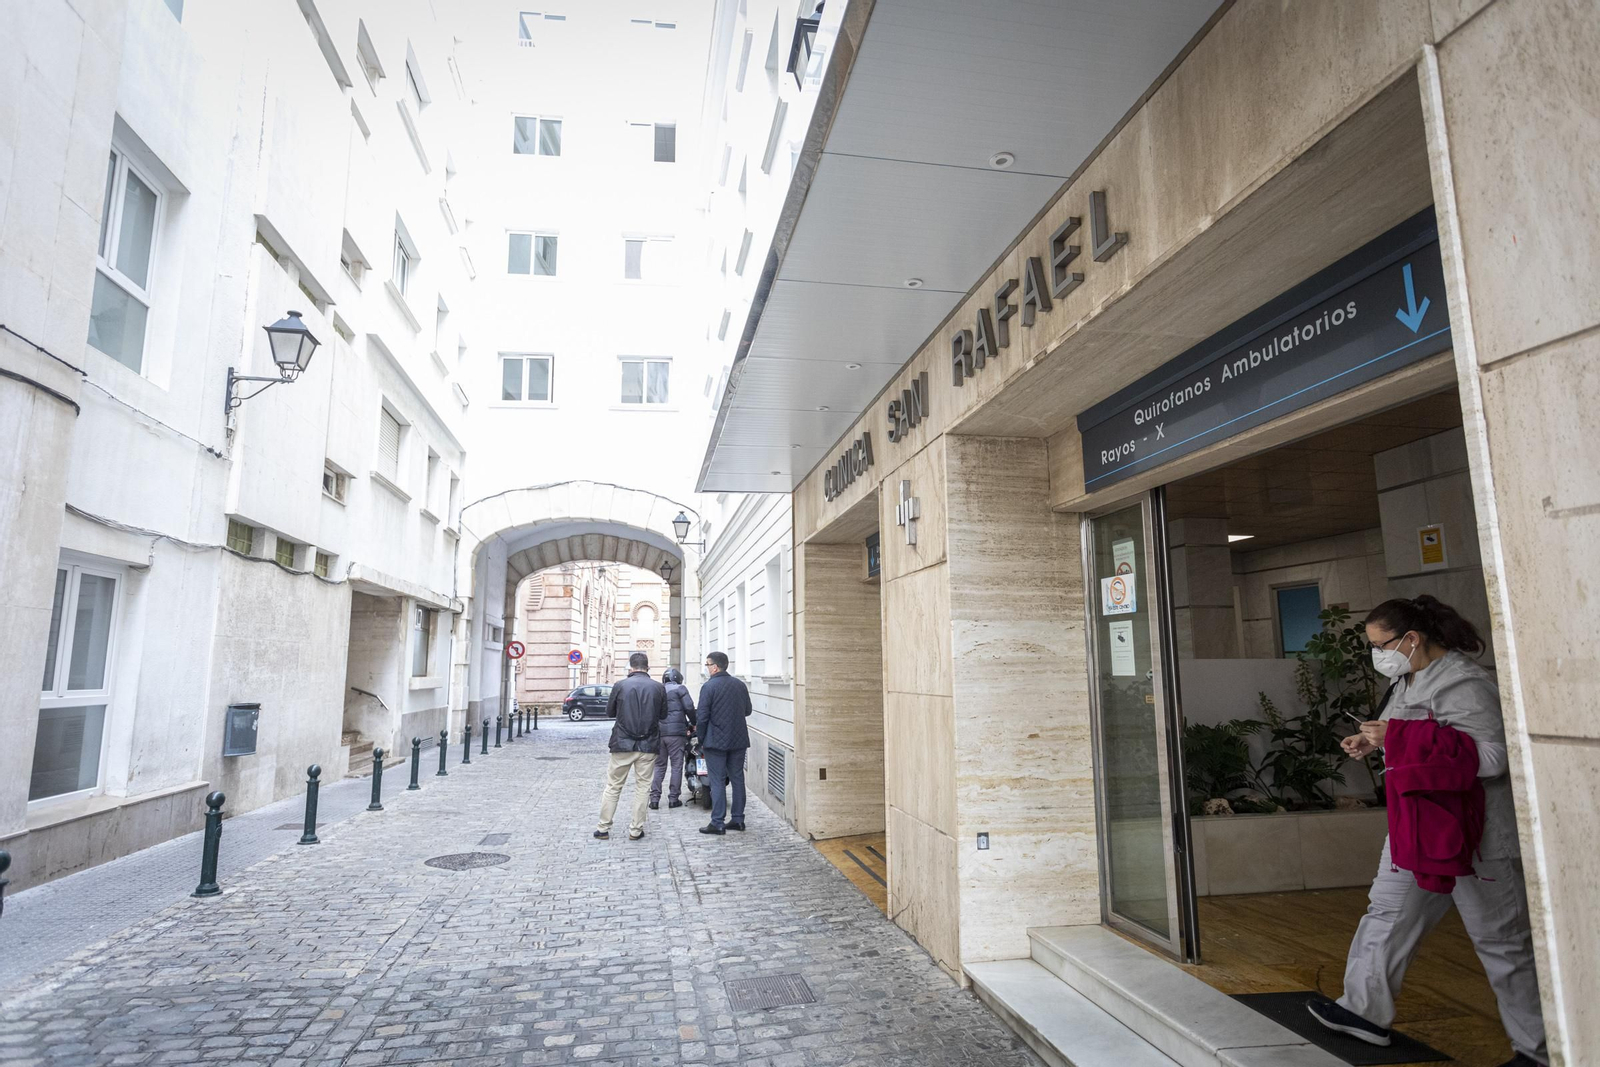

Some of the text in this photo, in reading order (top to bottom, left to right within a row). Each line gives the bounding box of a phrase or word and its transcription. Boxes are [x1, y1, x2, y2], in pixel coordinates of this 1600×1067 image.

[824, 190, 1128, 502] CLINICA SAN RAFAEL
[1134, 301, 1358, 426] Quirofanos Ambulatorios
[1101, 440, 1136, 465] Rayos
[1155, 423, 1166, 441] X
